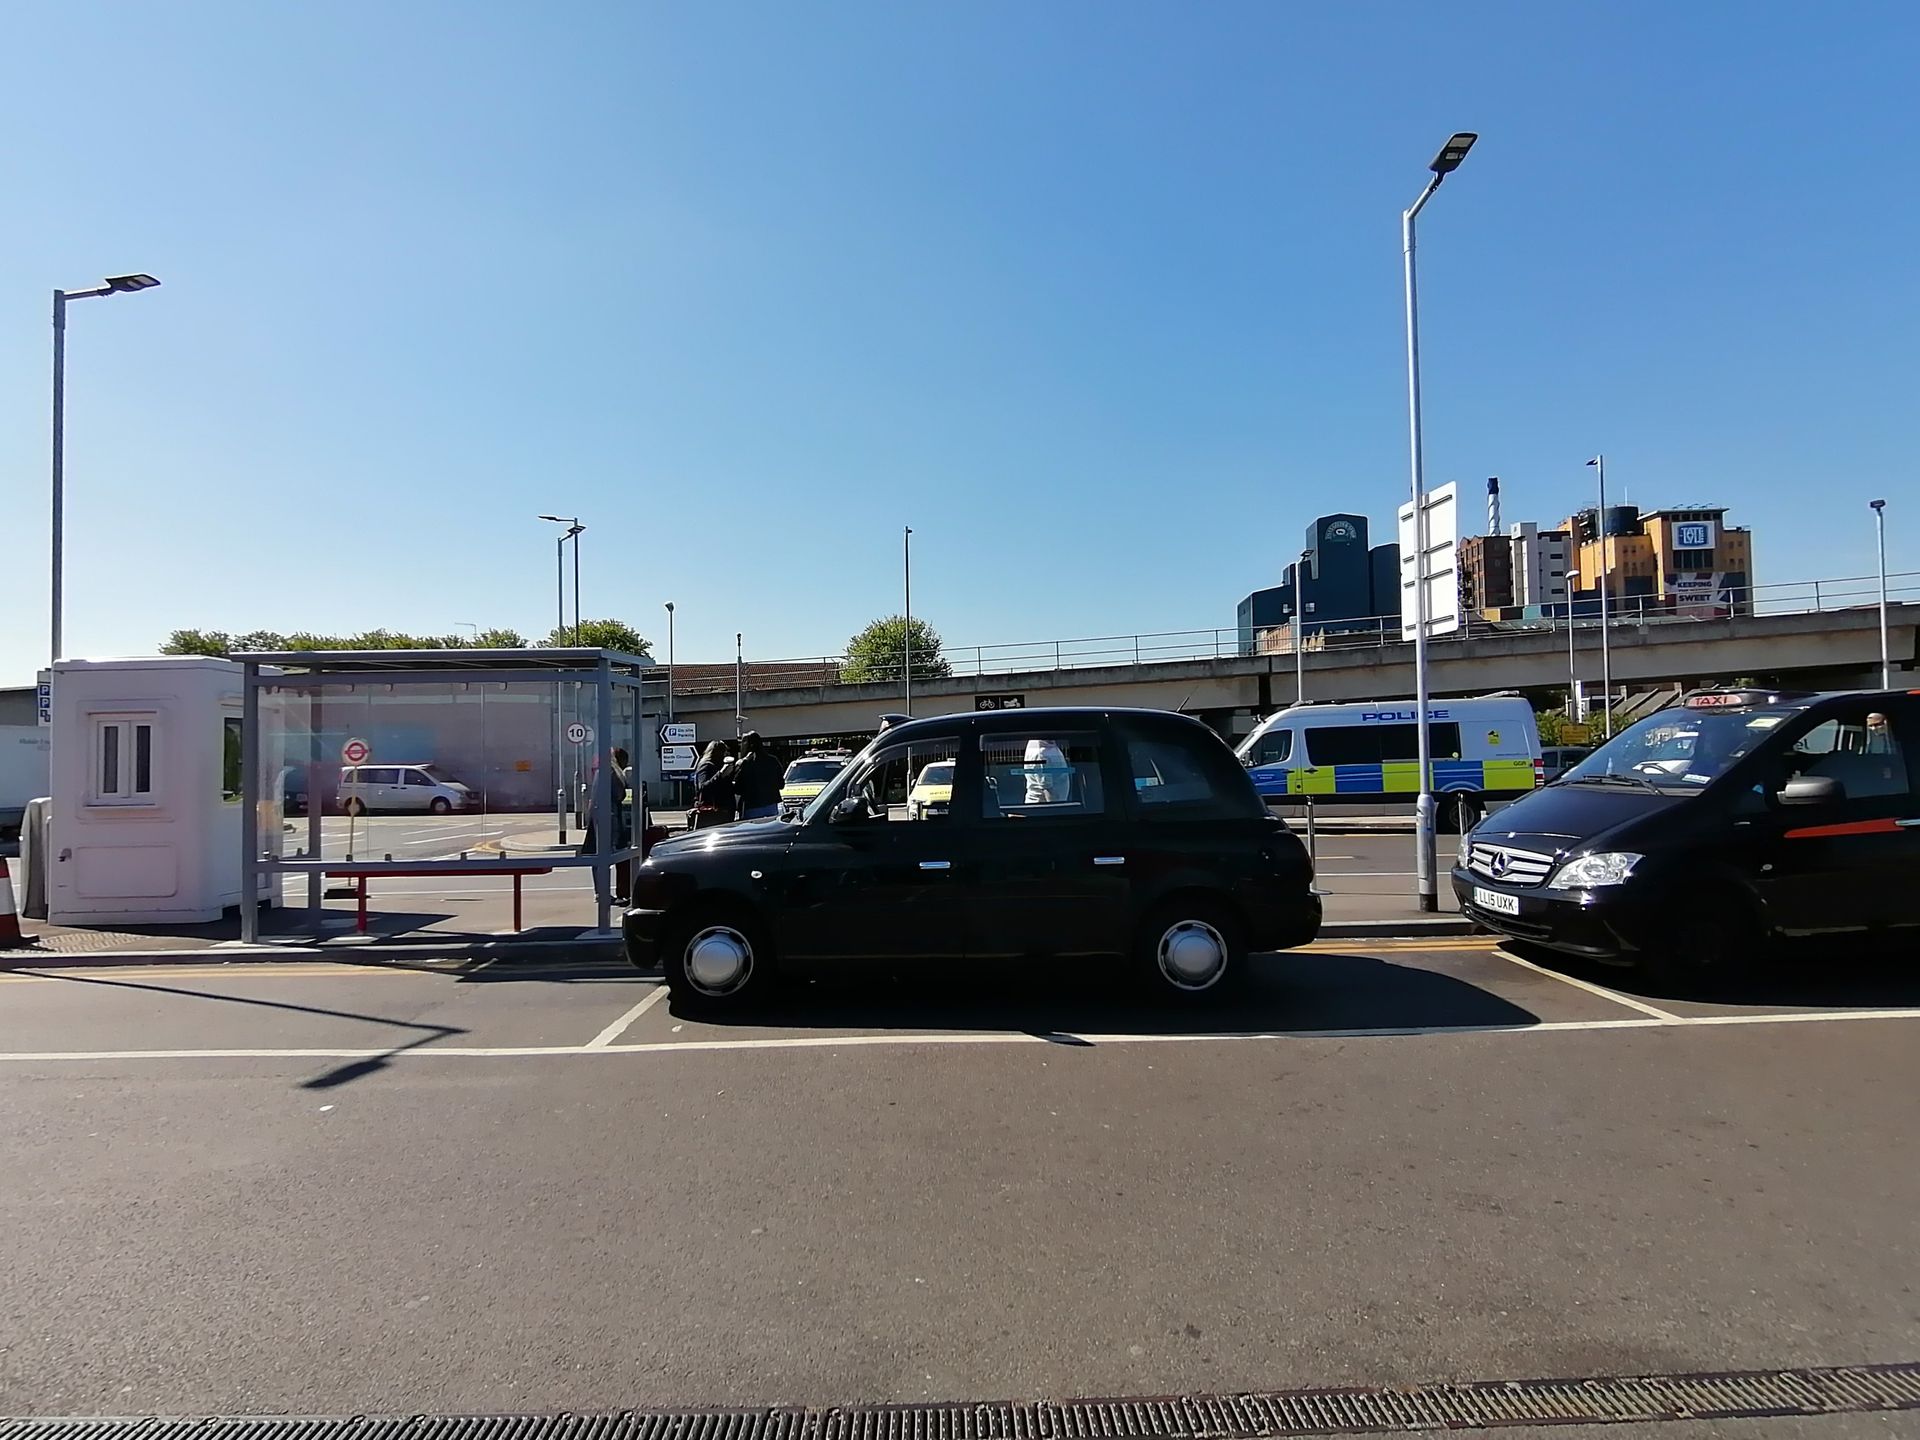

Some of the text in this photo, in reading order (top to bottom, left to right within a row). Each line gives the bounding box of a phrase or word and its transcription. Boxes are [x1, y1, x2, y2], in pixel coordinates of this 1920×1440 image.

[1678, 594, 1712, 602] SWEET
[1695, 696, 1728, 706] TAXI
[569, 728, 584, 738] 10
[1496, 896, 1515, 912] UXK
